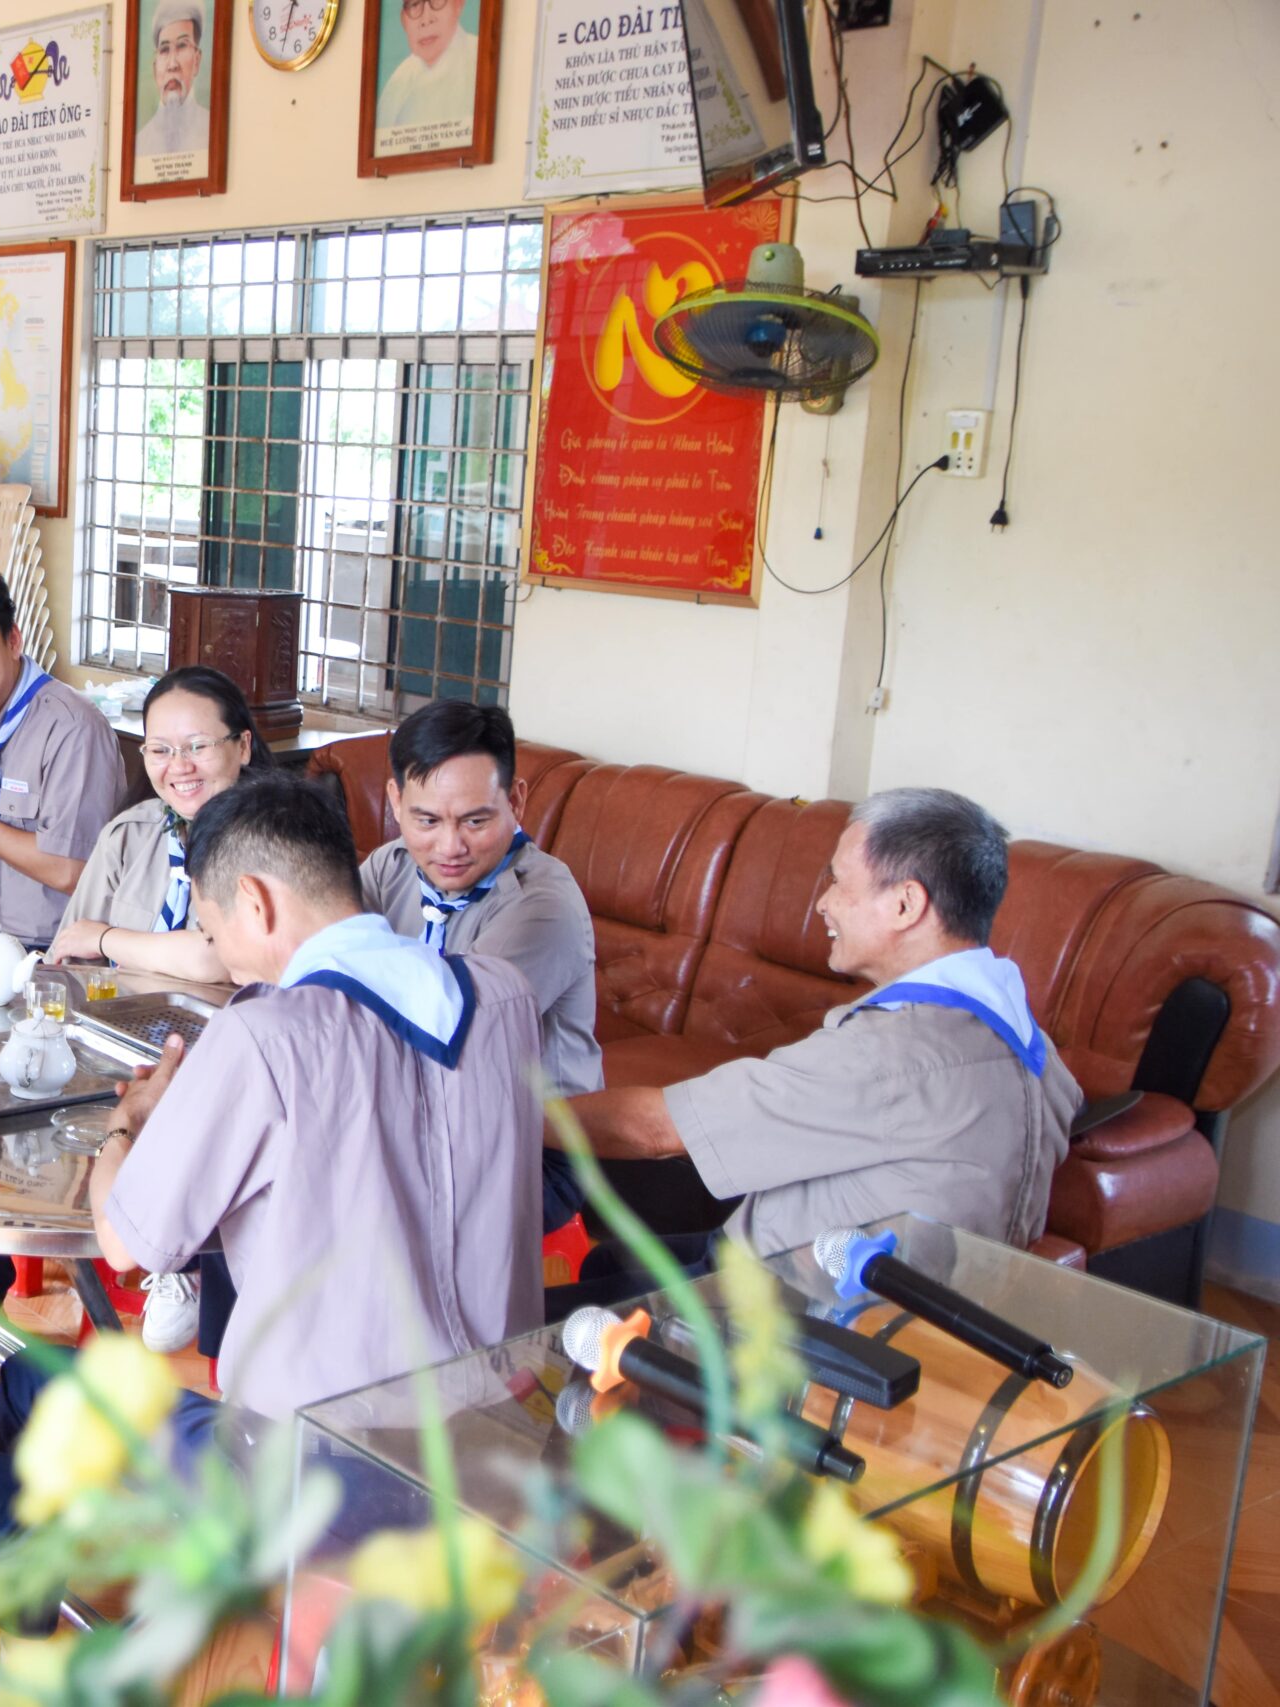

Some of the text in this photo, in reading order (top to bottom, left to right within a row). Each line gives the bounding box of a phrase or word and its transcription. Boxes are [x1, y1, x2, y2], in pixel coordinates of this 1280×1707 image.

[263, 6, 271, 20] 9
[574, 17, 611, 44] CAO
[618, 6, 653, 38] ĐÀI
[269, 26, 276, 40] 8
[308, 27, 316, 41] 5
[294, 39, 302, 53] 6
[653, 62, 674, 77] CAY
[11, 111, 29, 133] ĐÀI
[32, 106, 57, 129] TIÊN
[59, 103, 82, 125] ÔNG
